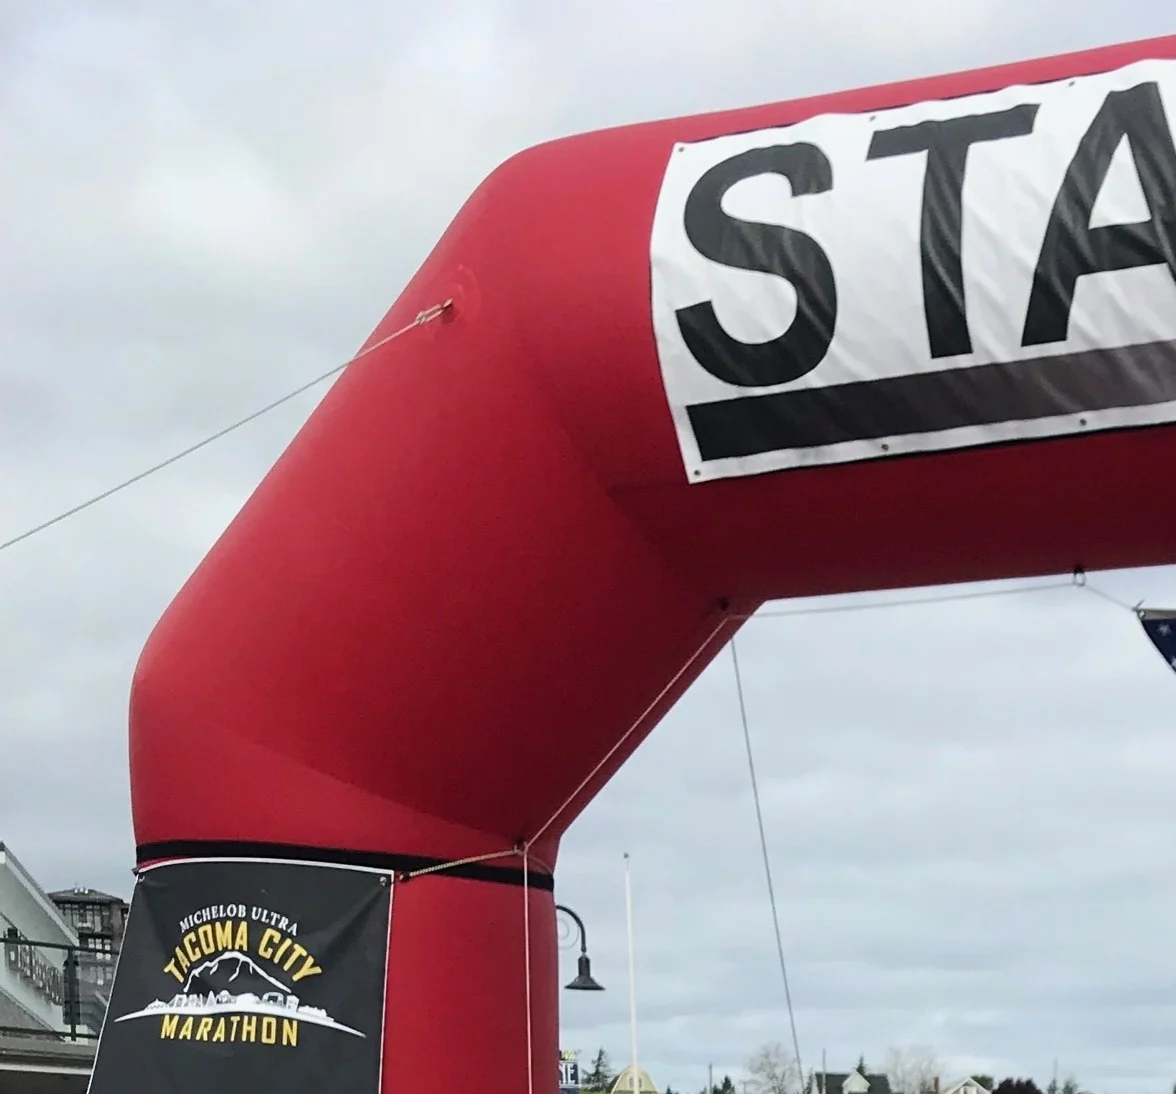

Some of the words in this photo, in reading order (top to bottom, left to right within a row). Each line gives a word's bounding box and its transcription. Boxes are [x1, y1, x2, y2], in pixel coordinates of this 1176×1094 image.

[179, 903, 247, 934] MICHELOB
[251, 905, 299, 937] ULTRA
[163, 920, 248, 984] TACOMA
[258, 927, 322, 983] CITY
[160, 1014, 299, 1047] MARATHON
